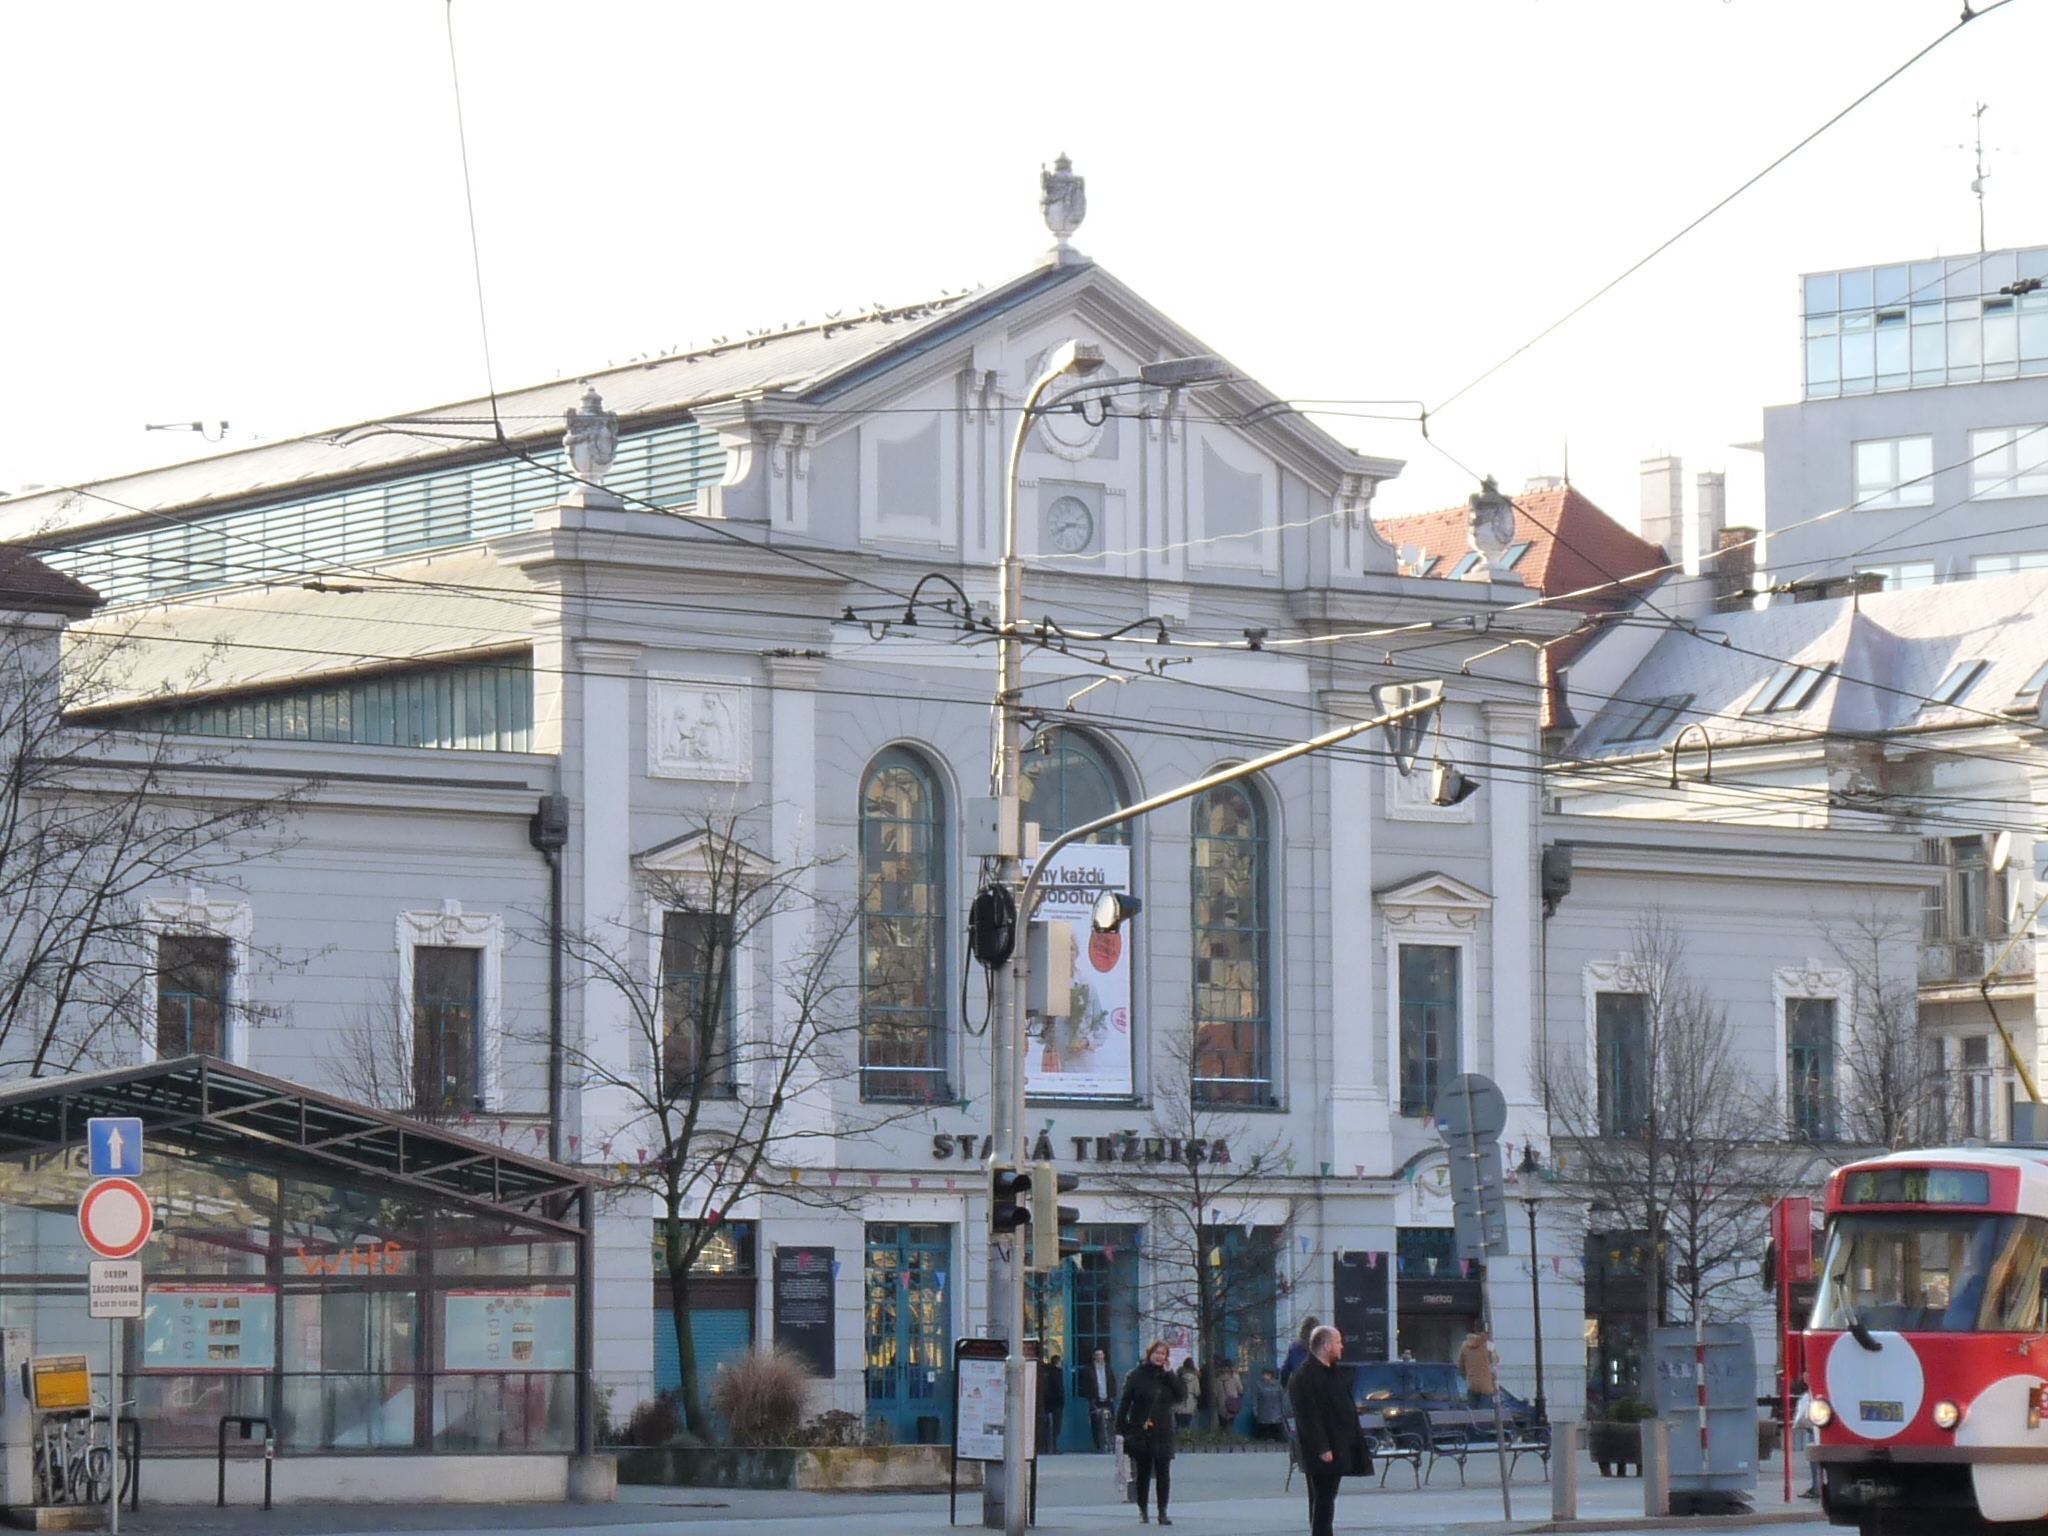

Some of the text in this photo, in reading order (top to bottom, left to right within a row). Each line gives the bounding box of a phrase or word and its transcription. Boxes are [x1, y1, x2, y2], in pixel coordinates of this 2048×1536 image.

[1061, 865, 1105, 885] každú
[1042, 887, 1096, 905] obotu
[932, 1129, 1232, 1164] STÁ TRŽNICA
[298, 1241, 401, 1276] WHS
[103, 1270, 128, 1279] OKREM
